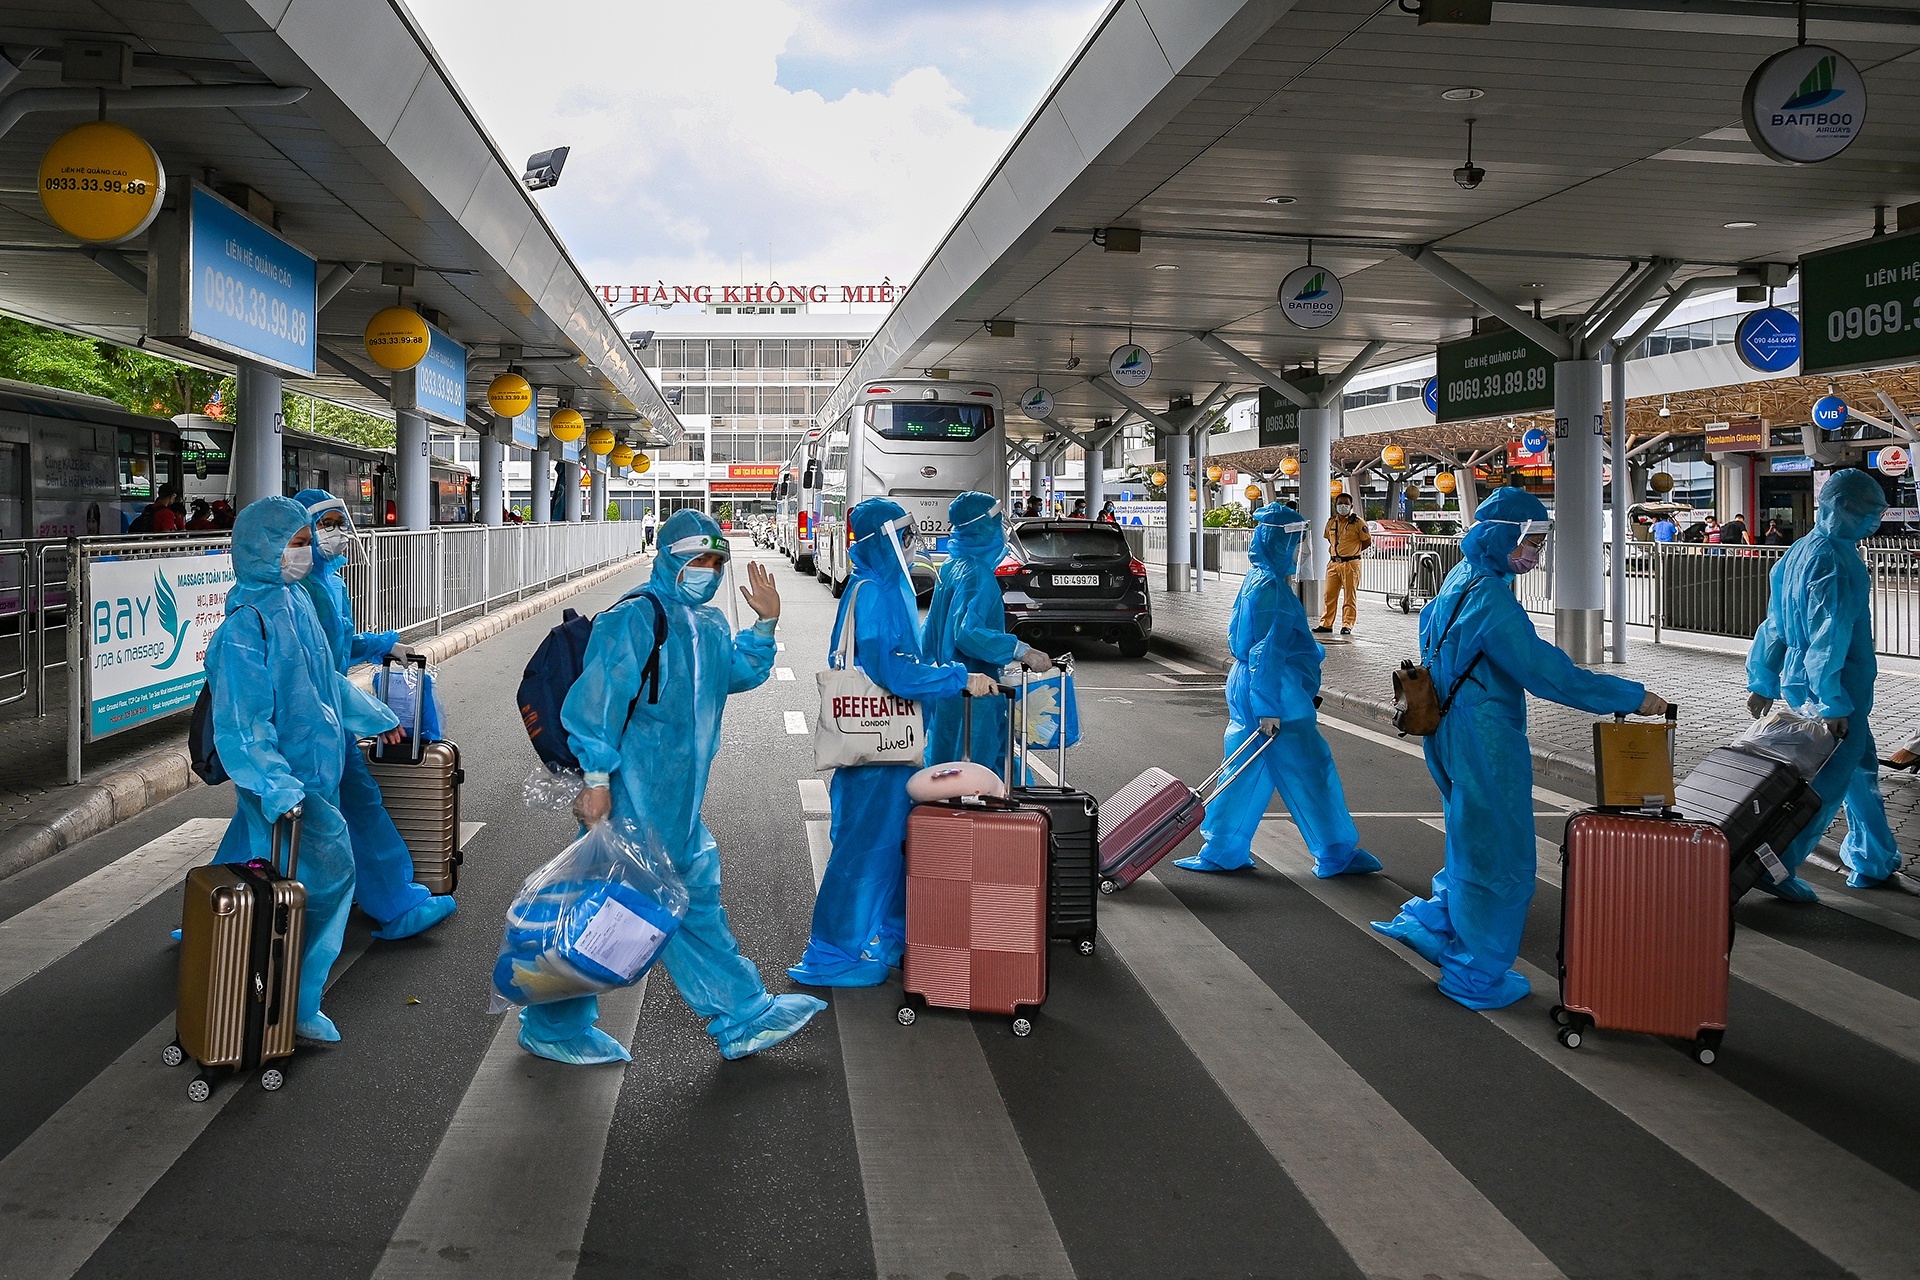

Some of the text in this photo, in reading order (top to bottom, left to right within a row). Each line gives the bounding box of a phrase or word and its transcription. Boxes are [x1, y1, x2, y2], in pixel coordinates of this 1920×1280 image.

[1772, 113, 1852, 126] BAMBOO
[112, 168, 127, 177] CÁO
[45, 177, 146, 195] 0933.33.99.88
[225, 239, 292, 289] LIÊN HỆ QUẢNG CÁO
[1865, 261, 1920, 287] LIÊN HỆ
[595, 276, 907, 307] Ụ HÀNG KHÔNG MIỀ
[204, 266, 307, 347] 0933.33.99.88
[1288, 302, 1334, 310] BAMBOO
[369, 336, 423, 345] 0933.33.99.88
[1464, 347, 1526, 368] LIÊN HỆ QUẢNG CÁO
[420, 366, 462, 407] 0933.33.99.88
[1448, 366, 1546, 402] 0969.39.89.89
[1819, 410, 1838, 419] VIB
[1706, 433, 1761, 445] Homtamin Ginseng
[177, 572, 205, 588] MASSAGE
[205, 568, 221, 584] TOÀN
[94, 642, 165, 670] spa & massage
[832, 694, 916, 719] BEEFEATER
